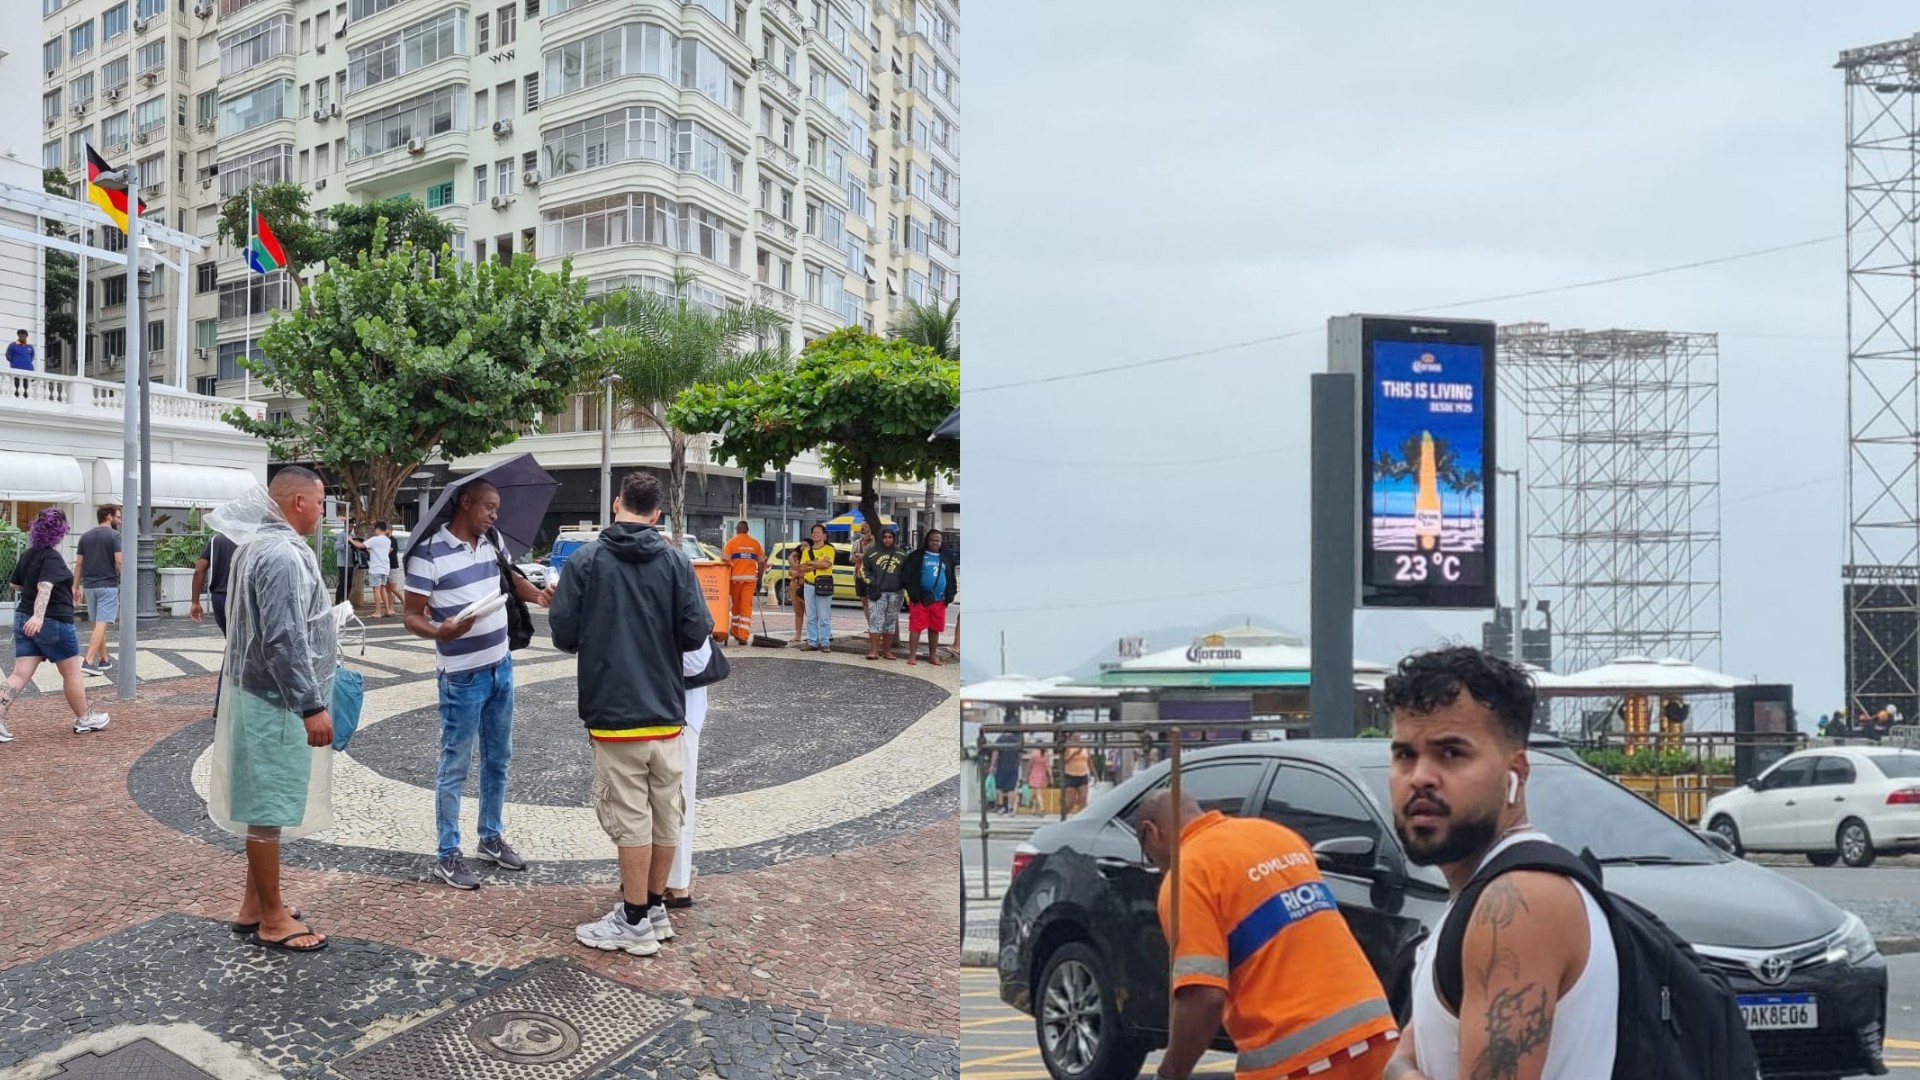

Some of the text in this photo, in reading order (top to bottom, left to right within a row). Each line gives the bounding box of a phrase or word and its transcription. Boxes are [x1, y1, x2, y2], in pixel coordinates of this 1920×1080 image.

[1382, 381, 1473, 401] THIS IS LIVING
[933, 566, 939, 577] 2
[1186, 642, 1242, 663] Corona
[1280, 885, 1315, 911] RIO
